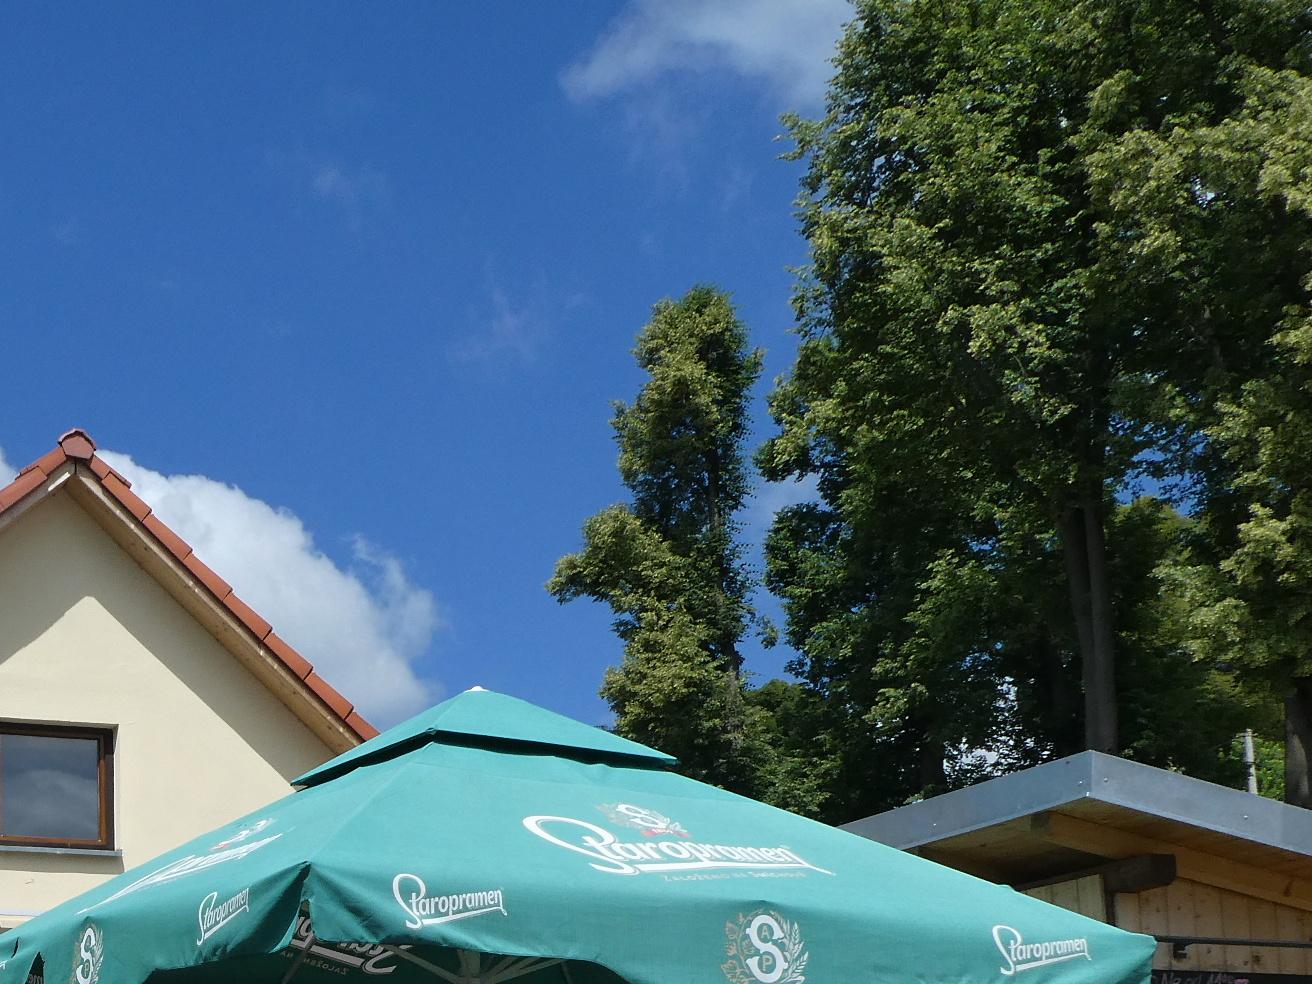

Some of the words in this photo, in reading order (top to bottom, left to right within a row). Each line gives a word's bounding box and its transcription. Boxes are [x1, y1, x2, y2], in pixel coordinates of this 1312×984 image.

[523, 815, 836, 876] Staropramen
[197, 888, 249, 946] Staropramen
[393, 873, 507, 929] Staropramen
[992, 925, 1092, 975] Staropramen
